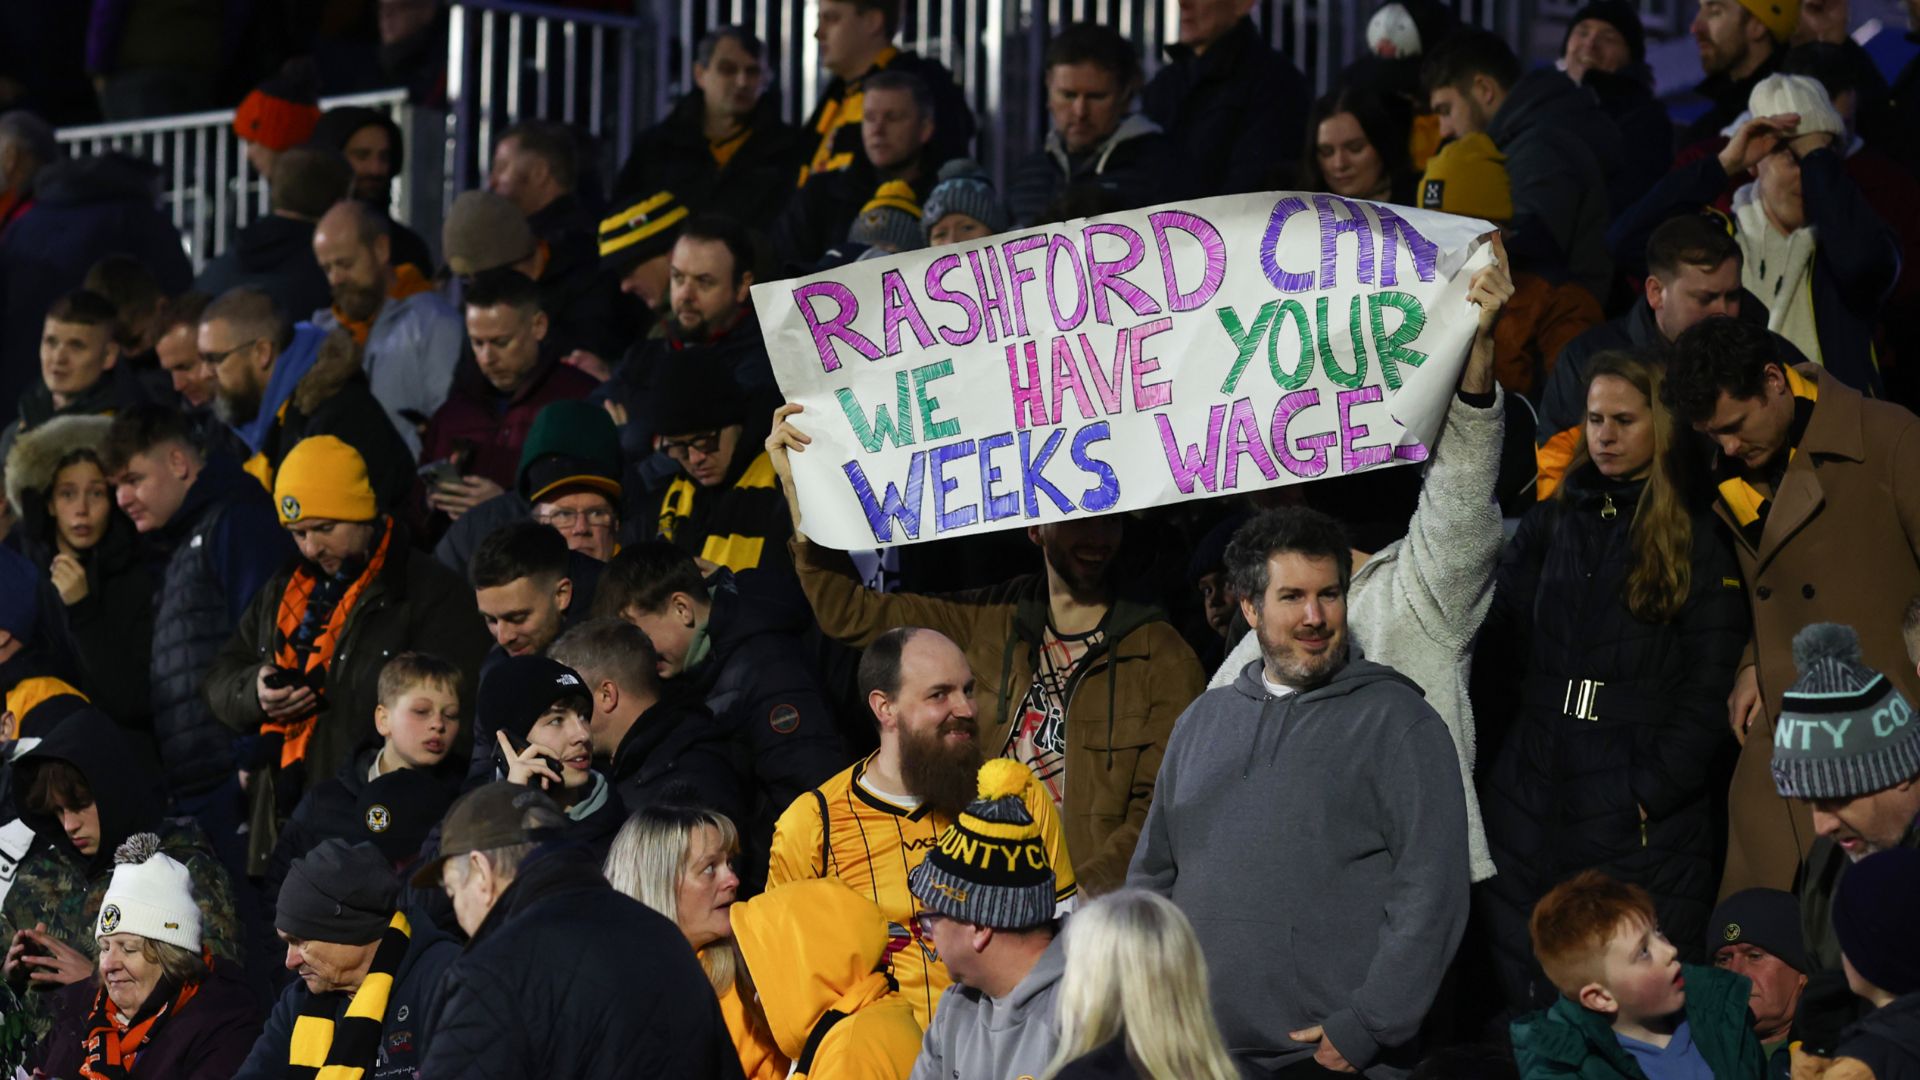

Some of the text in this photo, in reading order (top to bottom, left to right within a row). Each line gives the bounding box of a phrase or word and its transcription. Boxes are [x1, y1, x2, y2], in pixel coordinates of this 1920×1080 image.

[792, 195, 1439, 374] RASHFORD CAN
[834, 291, 1428, 453] WE HAVE YOUR
[842, 421, 1121, 544] WEEKS
[1872, 691, 1913, 738] CO
